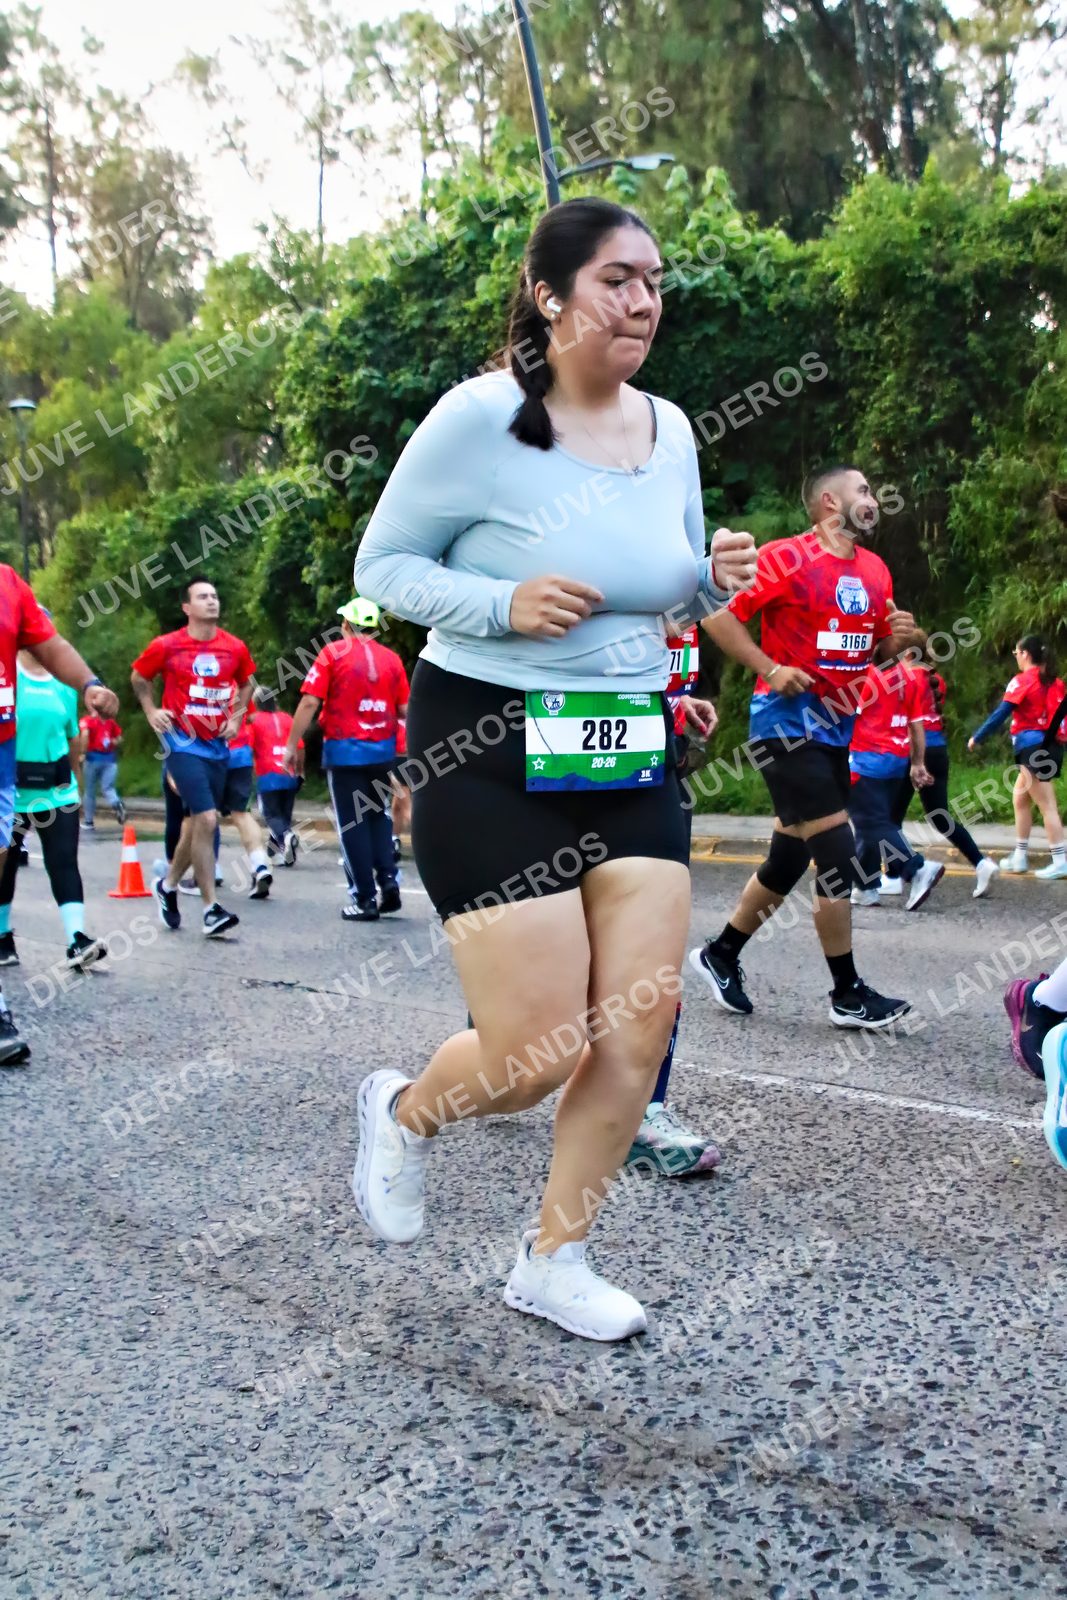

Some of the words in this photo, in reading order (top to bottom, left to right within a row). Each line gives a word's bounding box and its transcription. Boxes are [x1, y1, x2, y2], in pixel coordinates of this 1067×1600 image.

[841, 634, 867, 650] 3166
[582, 719, 628, 751] 282
[590, 756, 617, 769] 20-26
